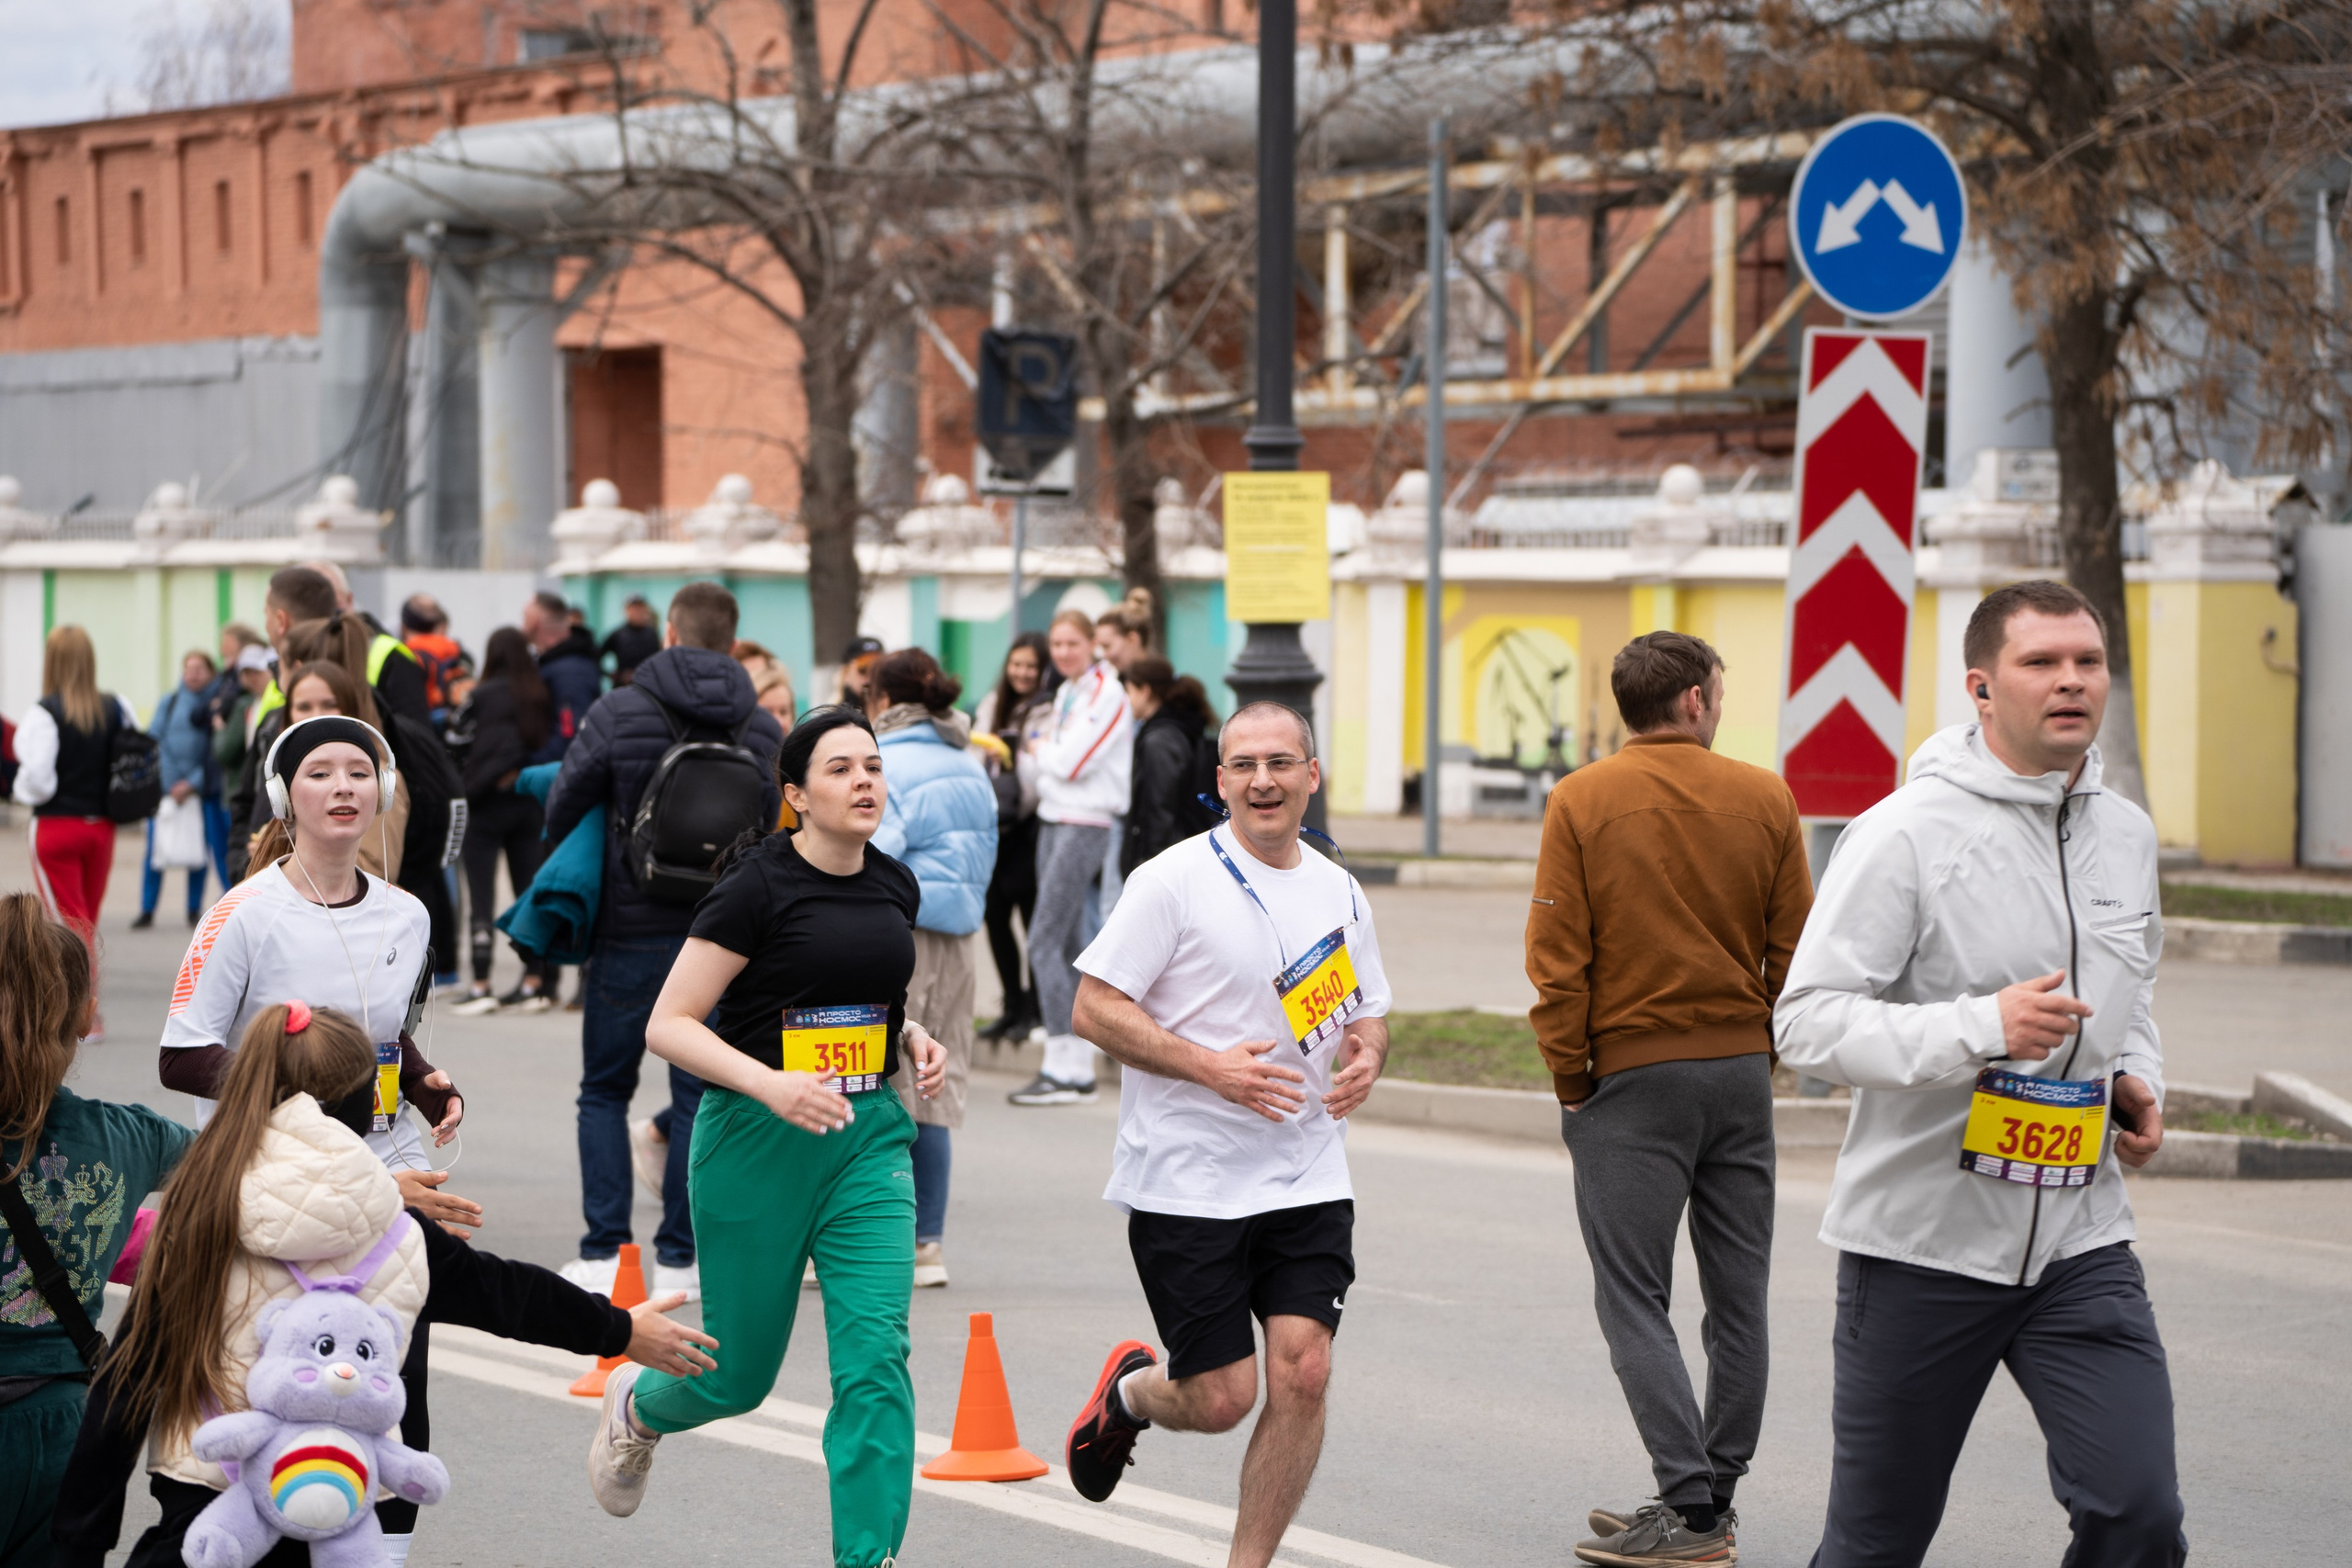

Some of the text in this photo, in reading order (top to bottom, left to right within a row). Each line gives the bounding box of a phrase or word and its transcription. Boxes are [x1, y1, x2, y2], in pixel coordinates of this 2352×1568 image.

[1300, 970, 1344, 1025] 3540
[819, 1015, 862, 1024] КОСМОС
[814, 1041, 866, 1074] 3511
[2023, 1089, 2080, 1102] КОСМОС
[2035, 1083, 2082, 1094] ПРОСТО
[1996, 1117, 2083, 1162] 3628
